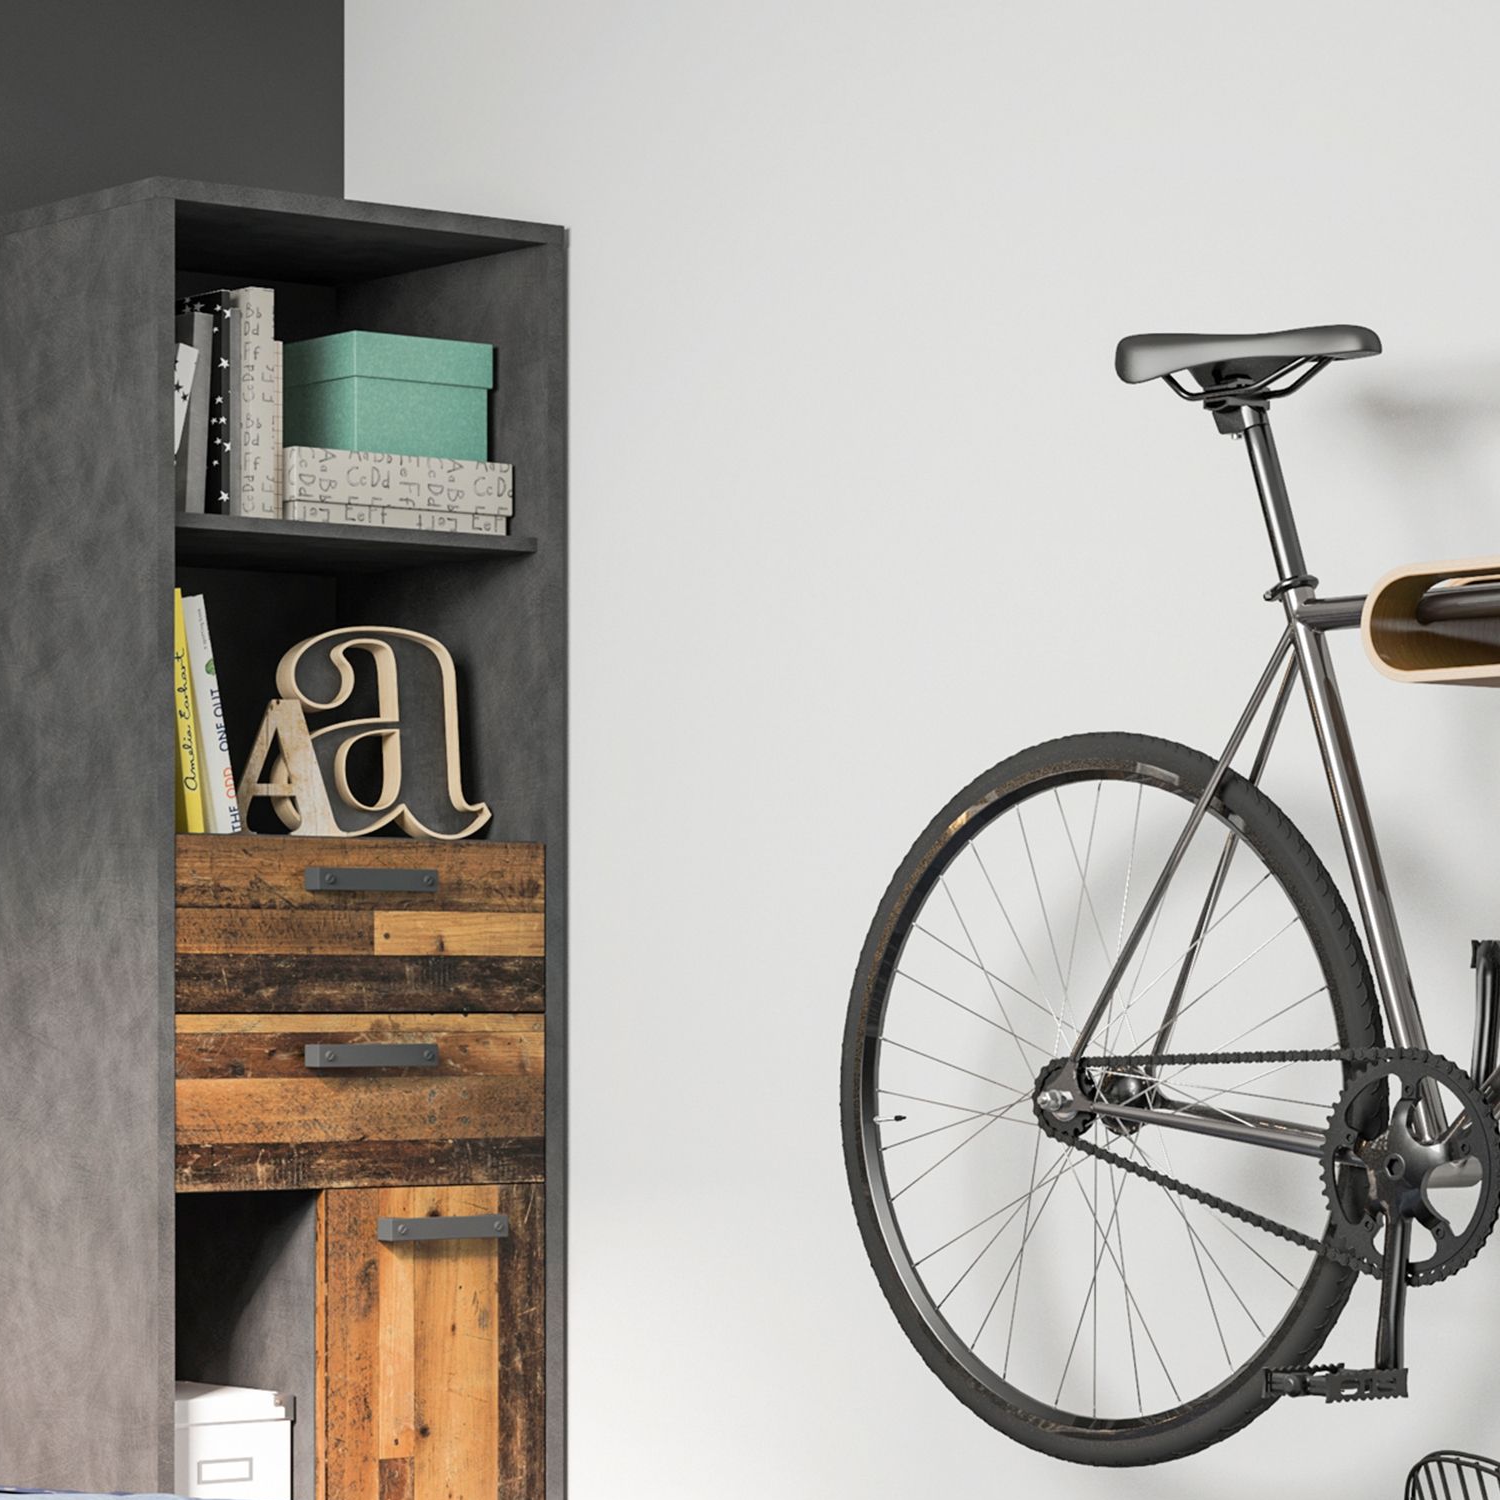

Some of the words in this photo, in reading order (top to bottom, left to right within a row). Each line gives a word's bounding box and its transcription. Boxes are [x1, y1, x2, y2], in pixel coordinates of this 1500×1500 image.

[174, 648, 192, 719] Earhart
[216, 723, 229, 752] ONE
[182, 725, 198, 791] Amelia
[223, 767, 237, 799] ODD
[228, 806, 242, 833] THE
